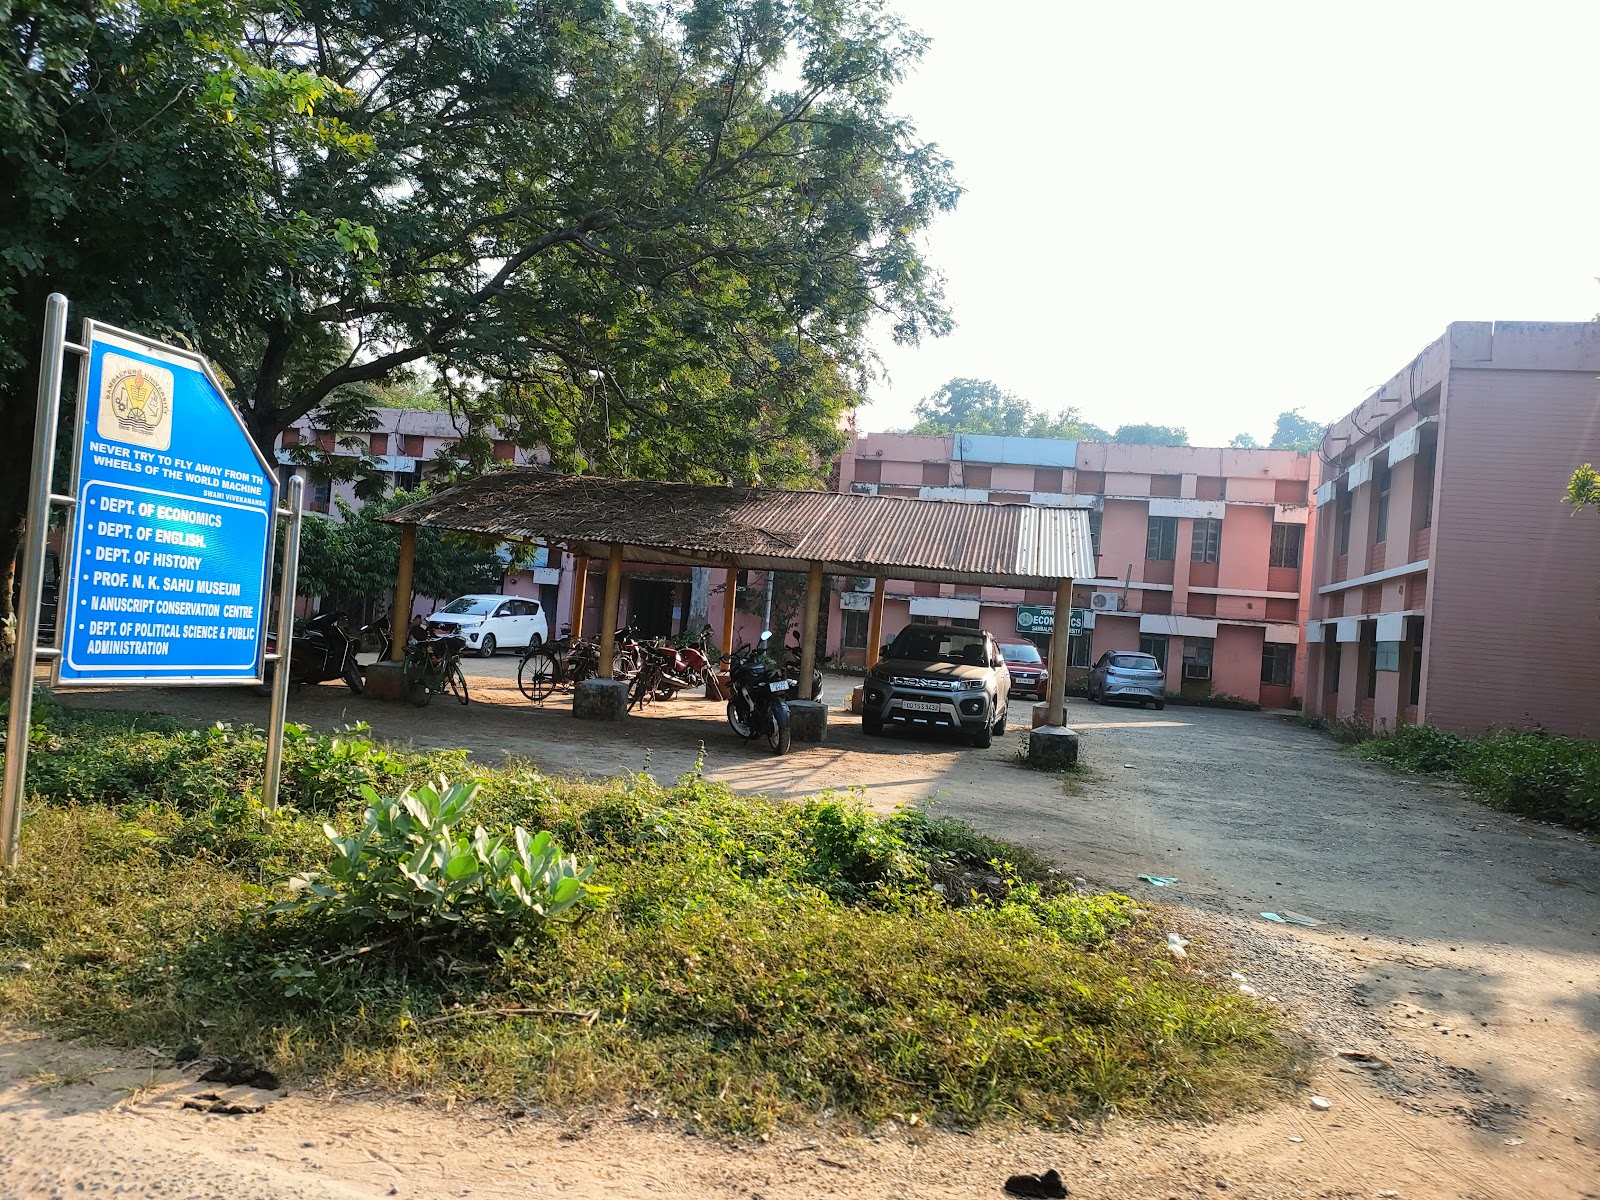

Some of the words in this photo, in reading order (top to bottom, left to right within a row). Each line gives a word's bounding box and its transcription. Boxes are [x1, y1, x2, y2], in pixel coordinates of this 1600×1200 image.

[89, 441, 130, 458] NEVER
[134, 450, 156, 462] TRY
[158, 455, 172, 466] TO
[175, 458, 193, 470] FLY
[195, 463, 223, 476] AWAY
[224, 469, 250, 482] FROM
[93, 455, 142, 473] WHEELS
[144, 464, 159, 476] OF
[162, 468, 183, 480] THE
[185, 472, 219, 488] WORLD
[221, 480, 262, 496] MACHINE
[203, 489, 224, 500] SWAMI
[225, 494, 267, 507] VIVEKANANDA
[100, 496, 135, 515] DEPT.
[138, 502, 155, 517] OF
[157, 506, 222, 528] ECONOMICS
[98, 521, 133, 540] DEPT.
[136, 526, 152, 541] OF
[95, 546, 131, 564] DEPT.
[134, 550, 150, 566] OF
[153, 552, 202, 571] HISTORY
[93, 571, 129, 588] PROF.
[132, 574, 145, 589] N.
[148, 576, 160, 590] K.
[163, 577, 194, 593] SAHU
[196, 580, 241, 596] MUSEUM
[156, 600, 220, 617] CONSERVATION
[223, 604, 253, 619] CENTRE
[89, 621, 117, 636] DEPT.
[119, 622, 133, 636] OF
[134, 623, 181, 638] POLITICAL
[182, 625, 218, 639] SCIENCE
[219, 626, 226, 639] &
[227, 627, 255, 640] PUBLIC
[87, 640, 169, 656] ADMINISTRATION
